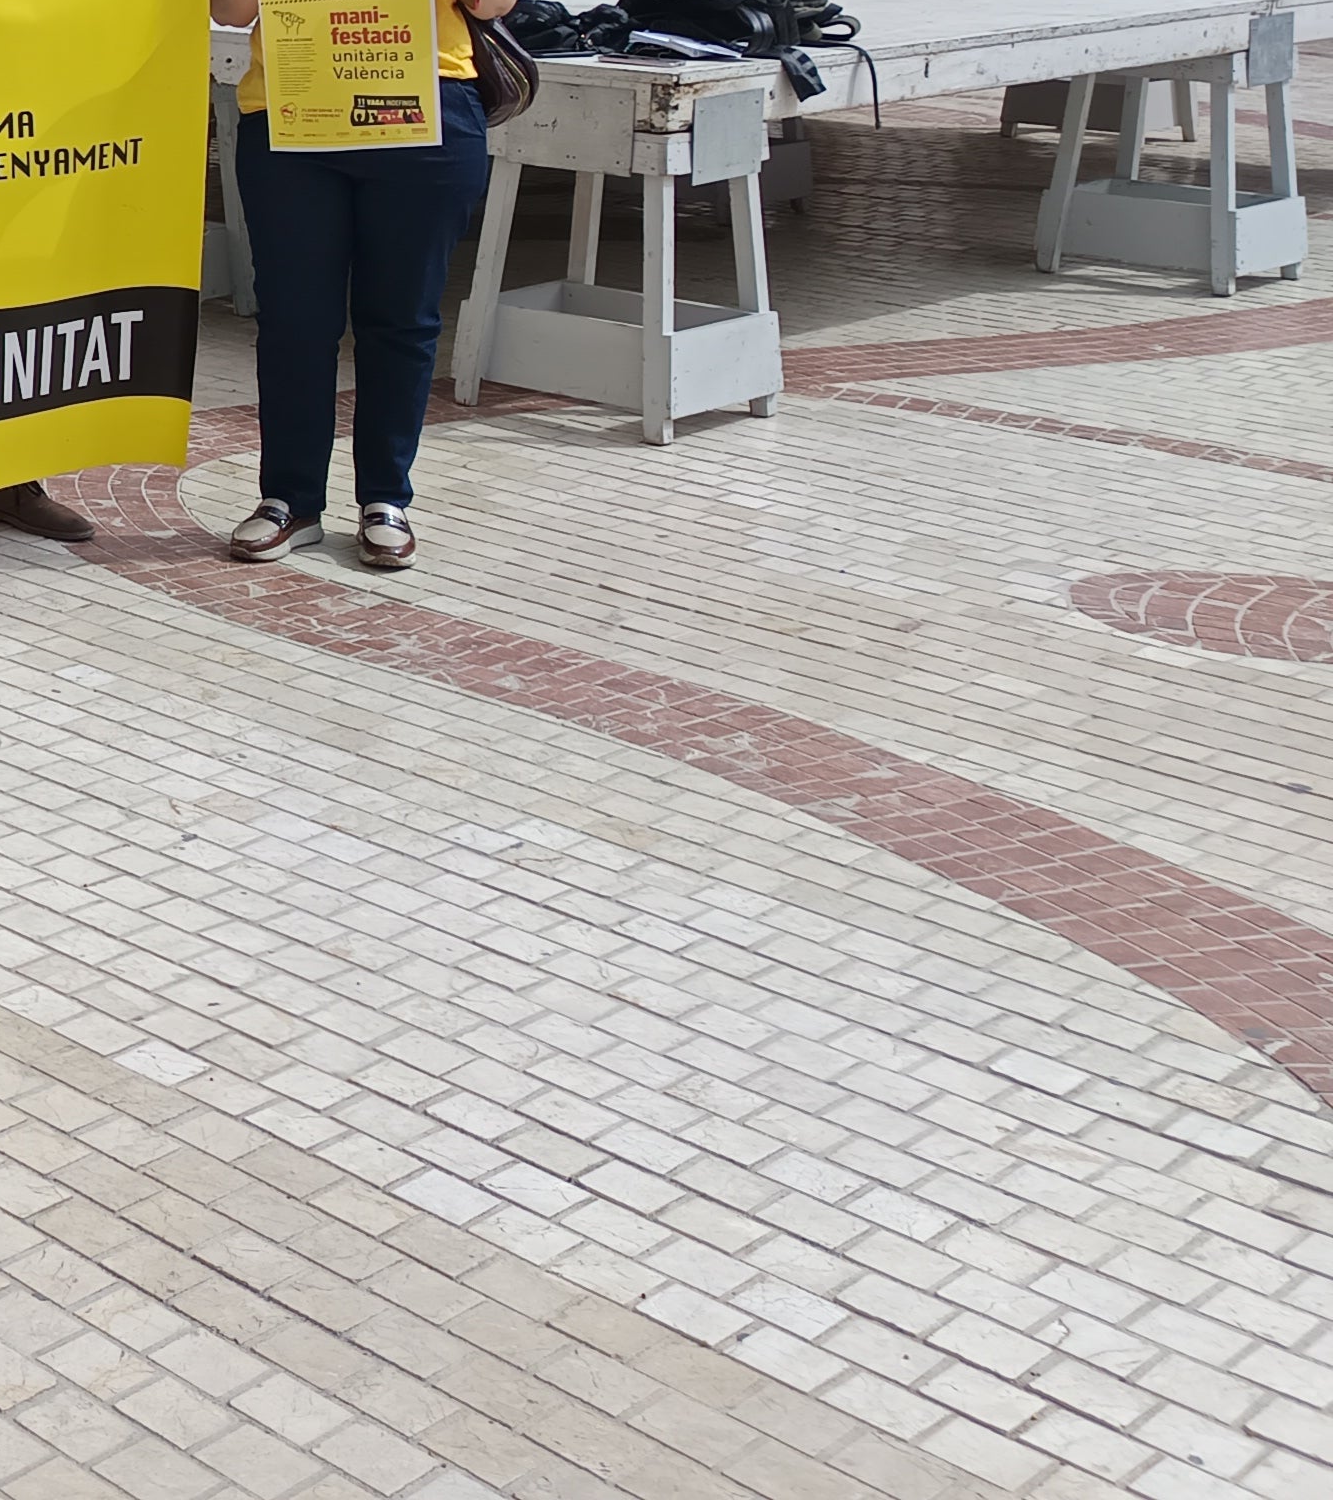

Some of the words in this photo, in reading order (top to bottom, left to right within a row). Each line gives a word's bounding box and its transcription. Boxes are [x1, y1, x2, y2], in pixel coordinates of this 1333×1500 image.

[330, 6, 389, 26] mani-
[330, 24, 412, 45] festació
[333, 51, 399, 63] unitària
[405, 52, 414, 62] a
[333, 66, 405, 80] València
